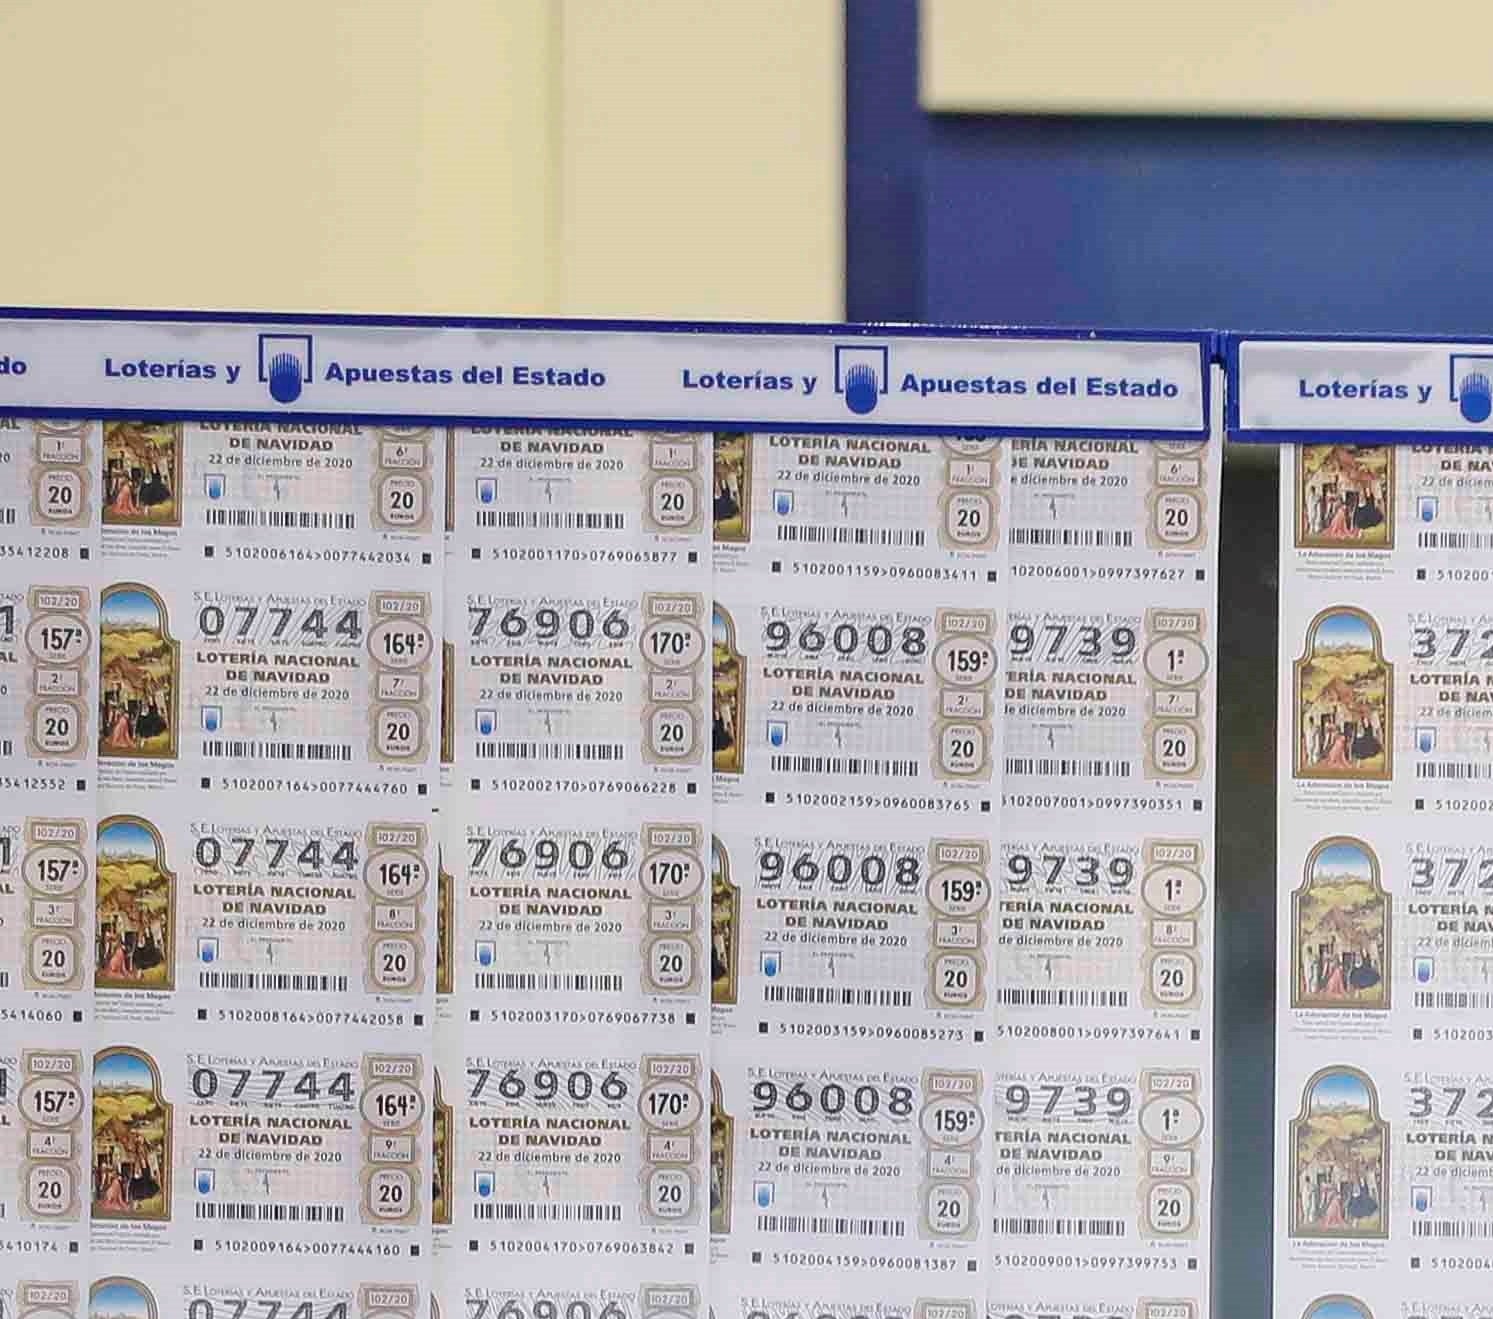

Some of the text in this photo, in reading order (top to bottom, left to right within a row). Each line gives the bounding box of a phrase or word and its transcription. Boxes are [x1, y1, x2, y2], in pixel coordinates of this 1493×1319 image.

[105, 357, 606, 387] Loterías y Apuestas del Estado
[1299, 378, 1409, 400] Loterías
[1417, 385, 1433, 404] y
[197, 604, 365, 645] 07744
[466, 604, 632, 643] 76906
[764, 618, 928, 659] 96008
[195, 651, 362, 671] LOTERÍA NACIONAL
[225, 669, 329, 684] DE NAVIDAD
